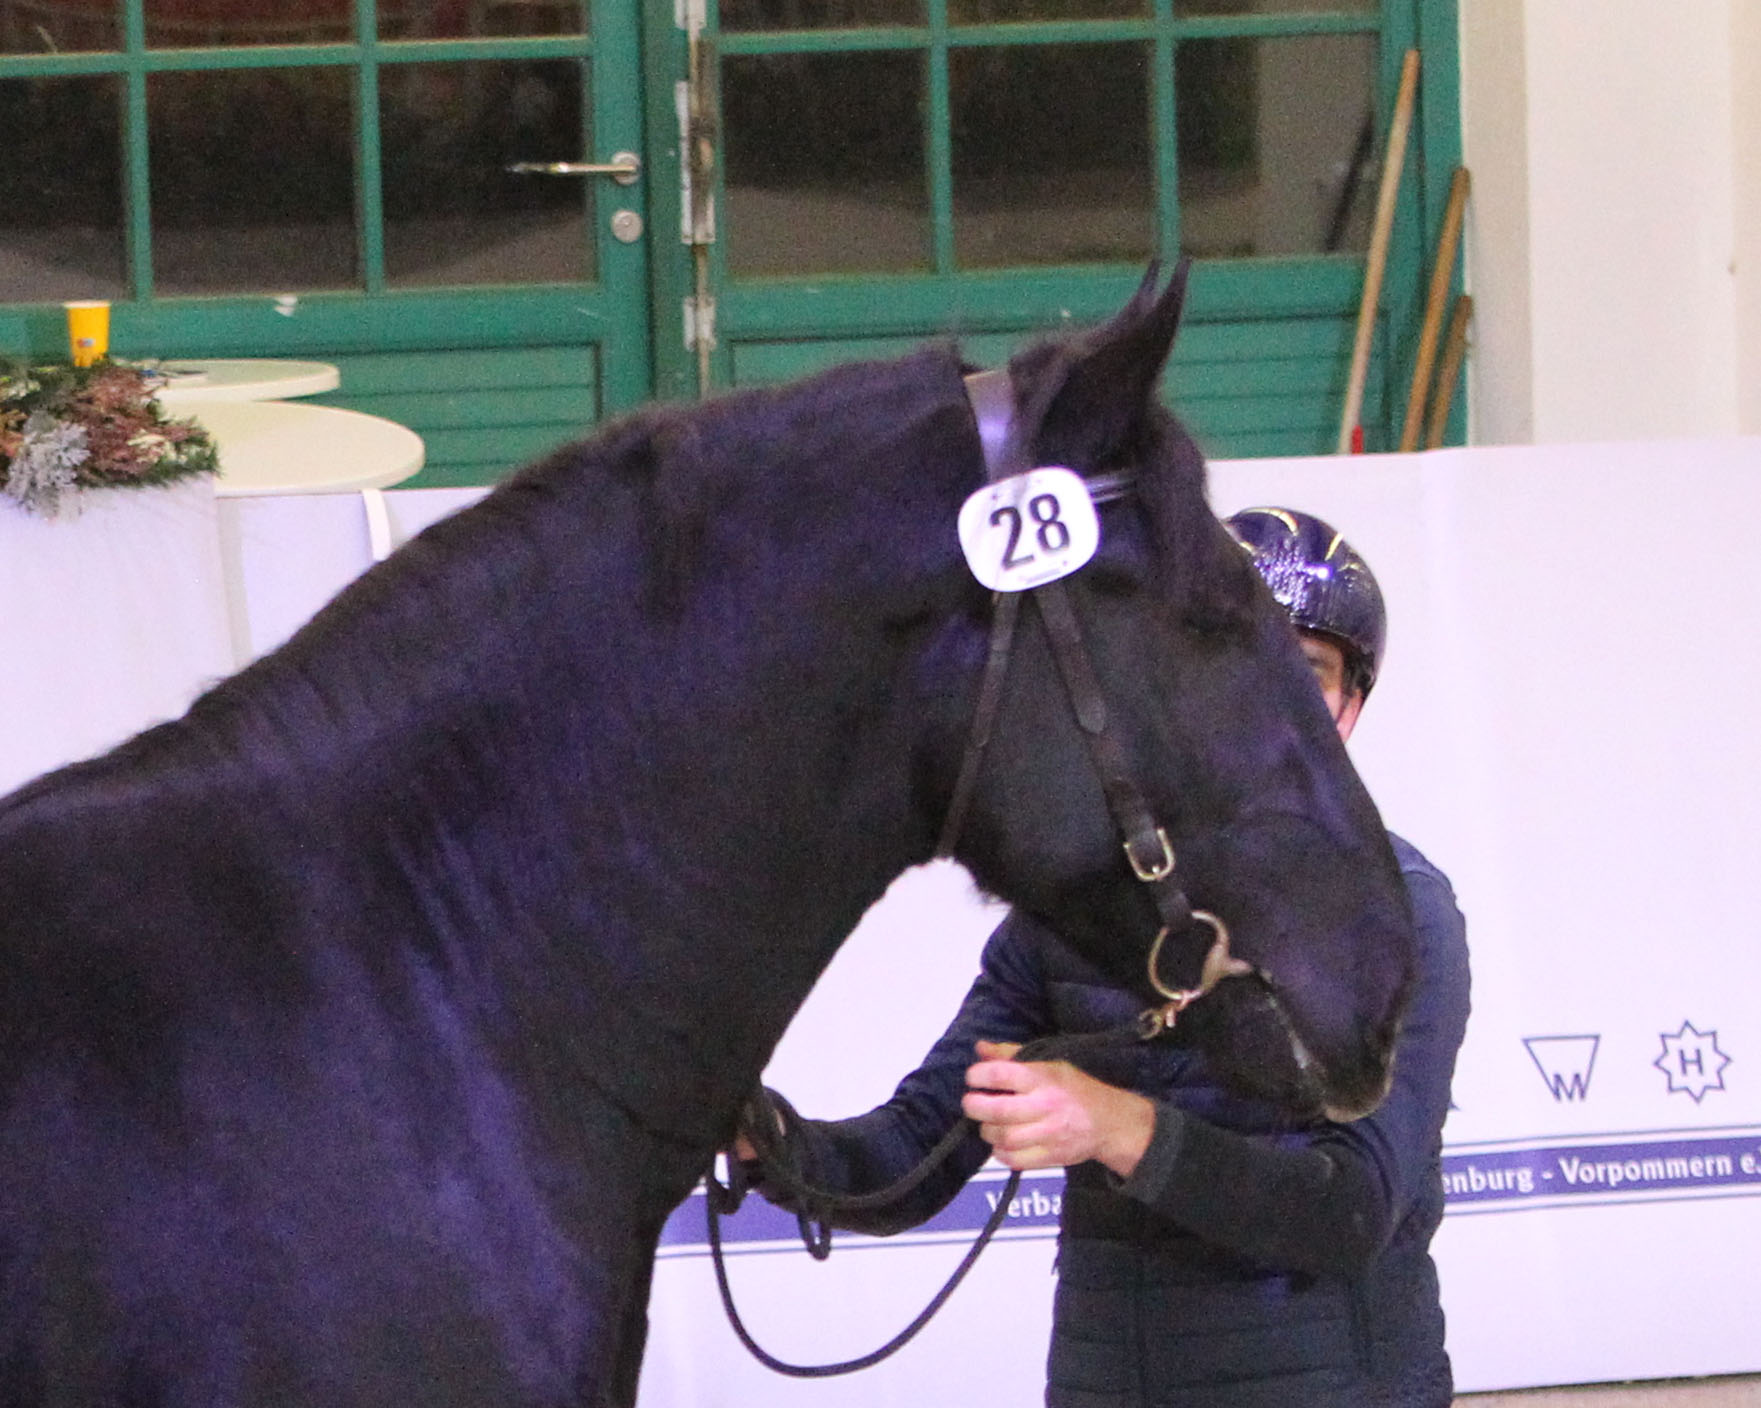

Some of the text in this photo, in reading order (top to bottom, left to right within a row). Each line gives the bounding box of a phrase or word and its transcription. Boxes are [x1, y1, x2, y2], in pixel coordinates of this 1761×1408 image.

[989, 493, 1071, 571] 28
[1678, 1048, 1704, 1076] H
[1558, 1154, 1734, 1187] Vorpommern
